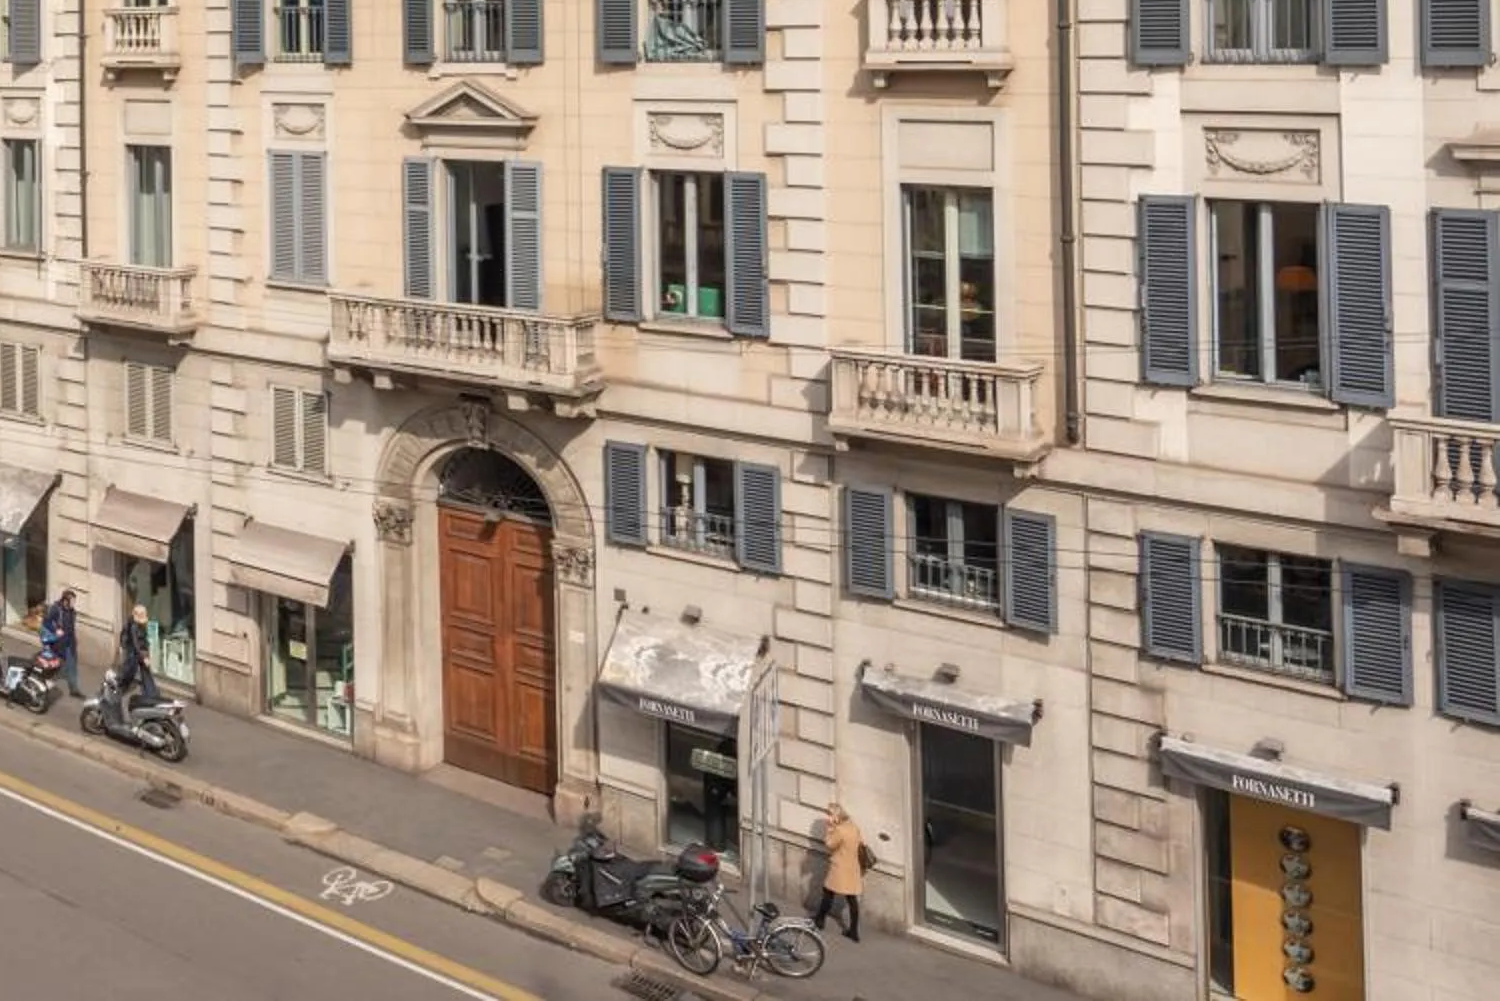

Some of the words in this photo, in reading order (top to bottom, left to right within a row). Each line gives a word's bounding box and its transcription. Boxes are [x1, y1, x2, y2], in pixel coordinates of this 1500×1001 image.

[639, 698, 695, 722] FORNASETTI
[913, 702, 978, 731] FORNASETTI
[1232, 774, 1315, 808] FORNASETTI
